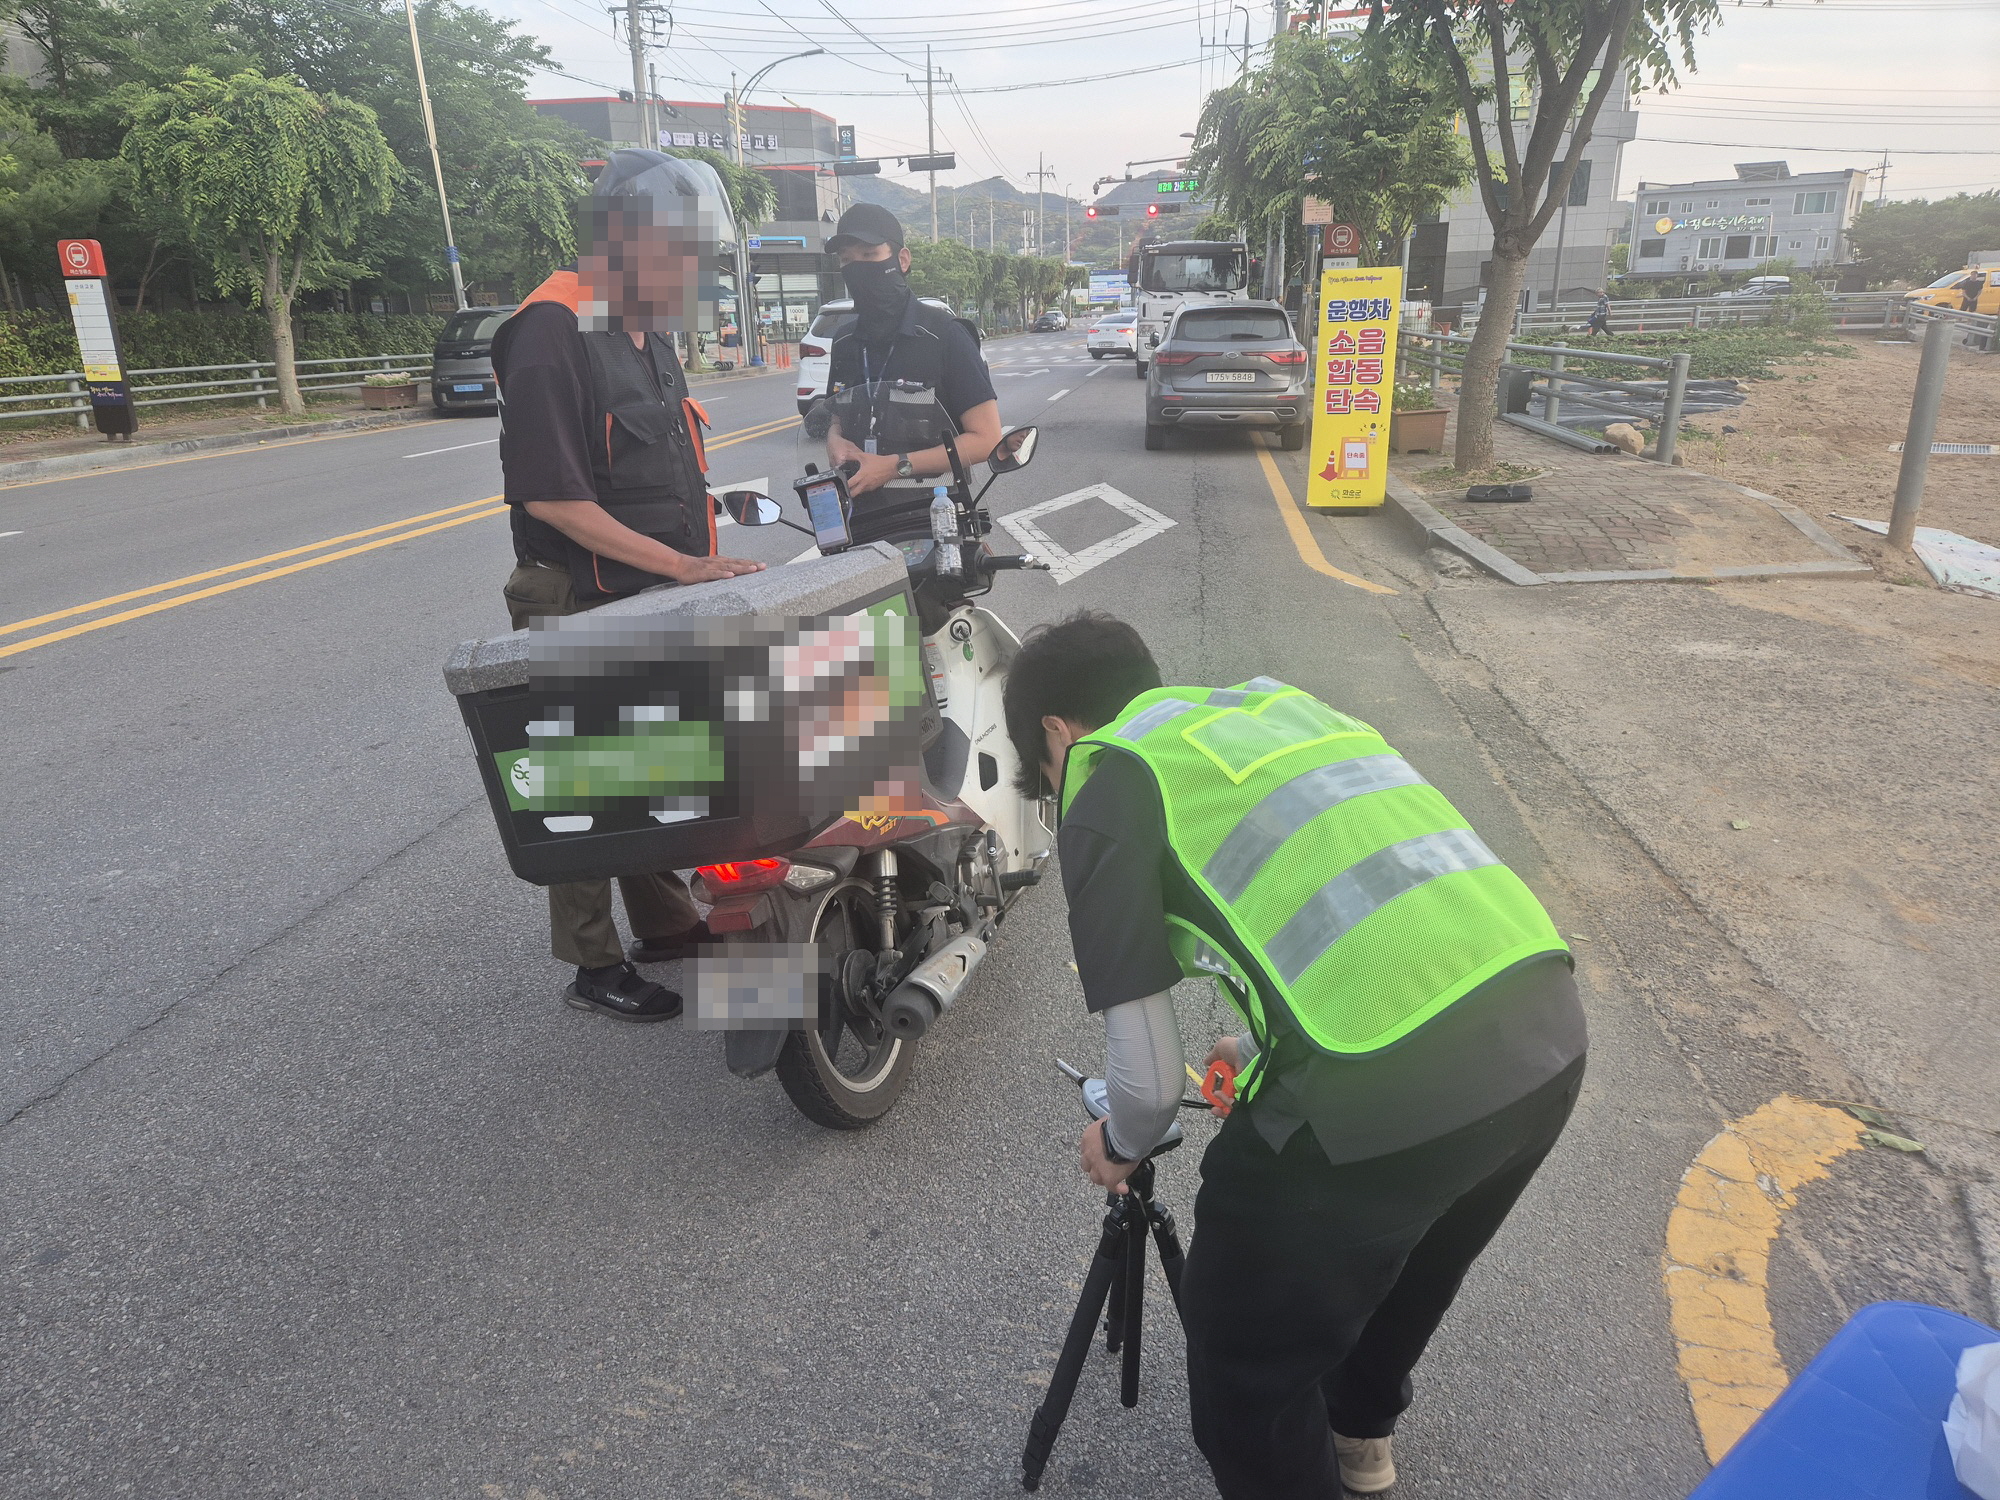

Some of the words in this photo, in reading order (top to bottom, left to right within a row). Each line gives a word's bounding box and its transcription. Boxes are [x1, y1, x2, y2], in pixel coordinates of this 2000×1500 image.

[697, 131, 778, 150] 화순일교회
[841, 130, 851, 138] GS
[842, 137, 852, 145] 25
[1327, 298, 1391, 322] 운행차
[1328, 328, 1386, 355] 소음
[1232, 373, 1252, 381] 5848
[1327, 358, 1383, 385] 합동
[1325, 388, 1380, 414] 단속
[879, 817, 898, 836] BEST
